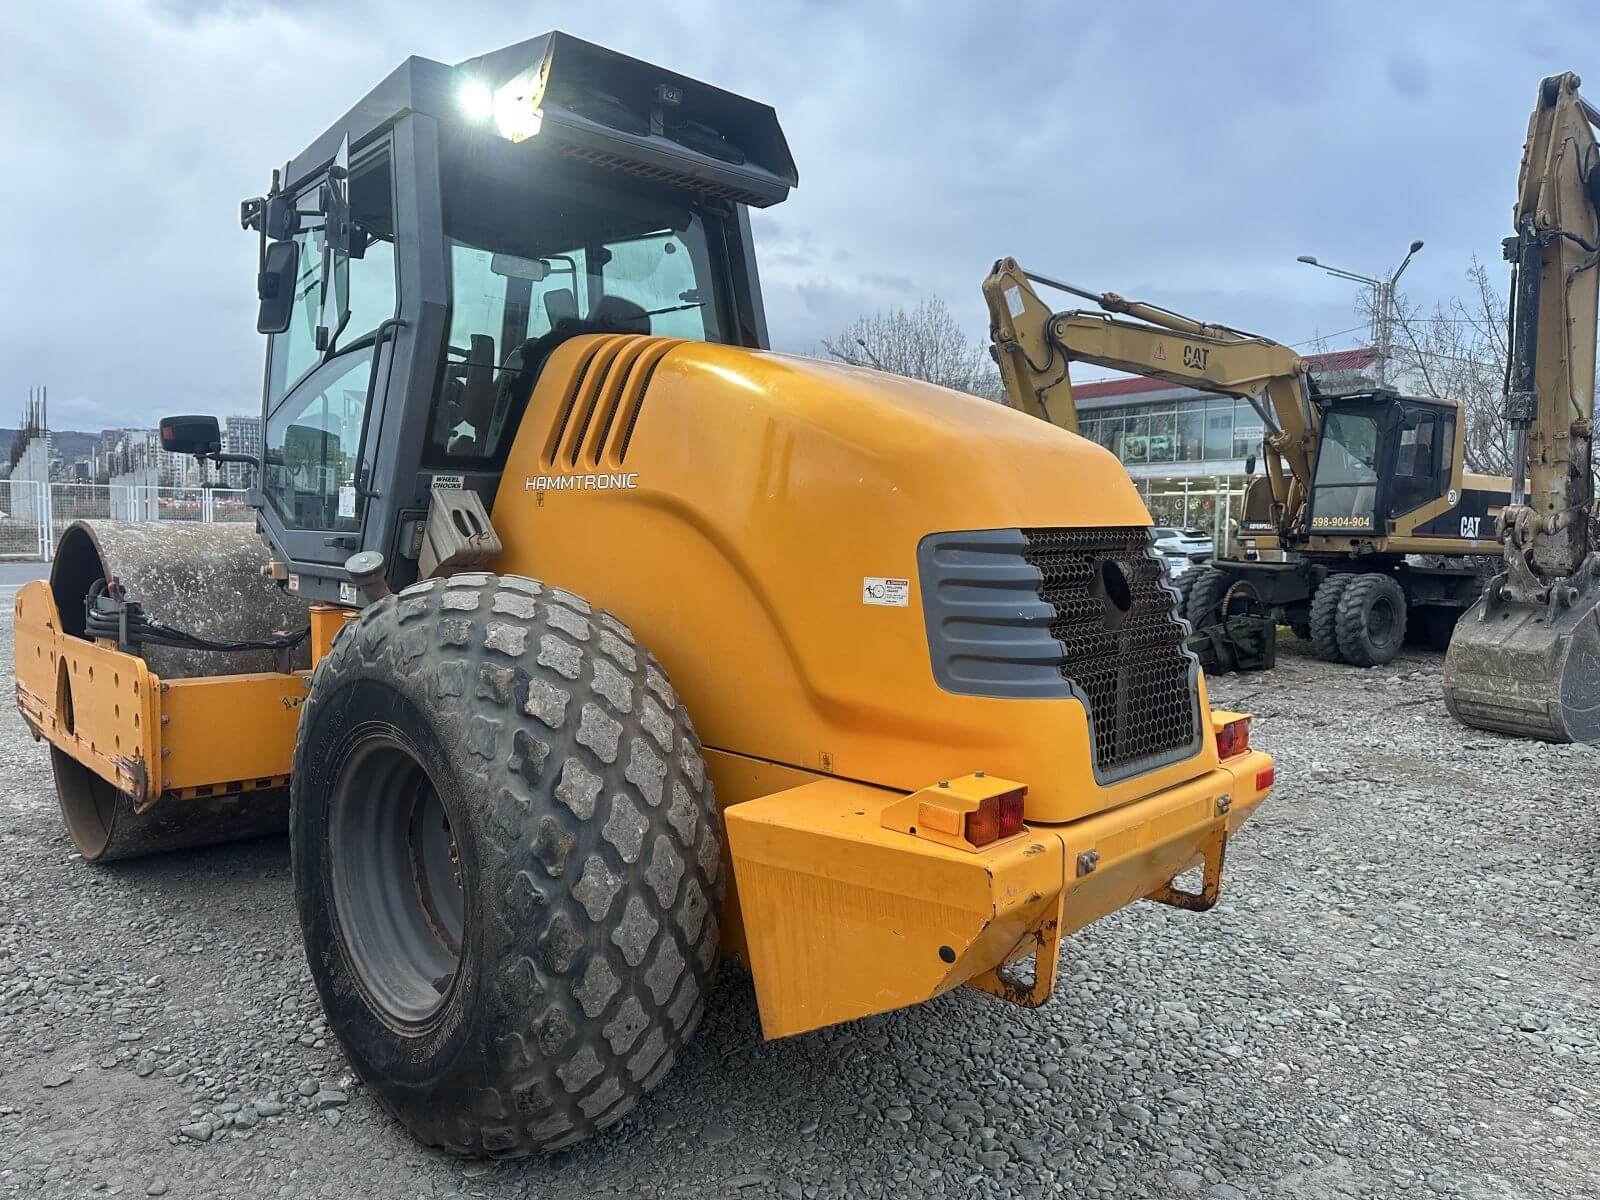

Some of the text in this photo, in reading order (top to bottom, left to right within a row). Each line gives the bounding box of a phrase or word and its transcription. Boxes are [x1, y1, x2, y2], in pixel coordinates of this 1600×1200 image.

[1183, 345, 1210, 370] CAT
[525, 473, 639, 491] HAMMTRONIC
[1312, 516, 1370, 527] 598-904-904
[1460, 516, 1481, 538] CAT
